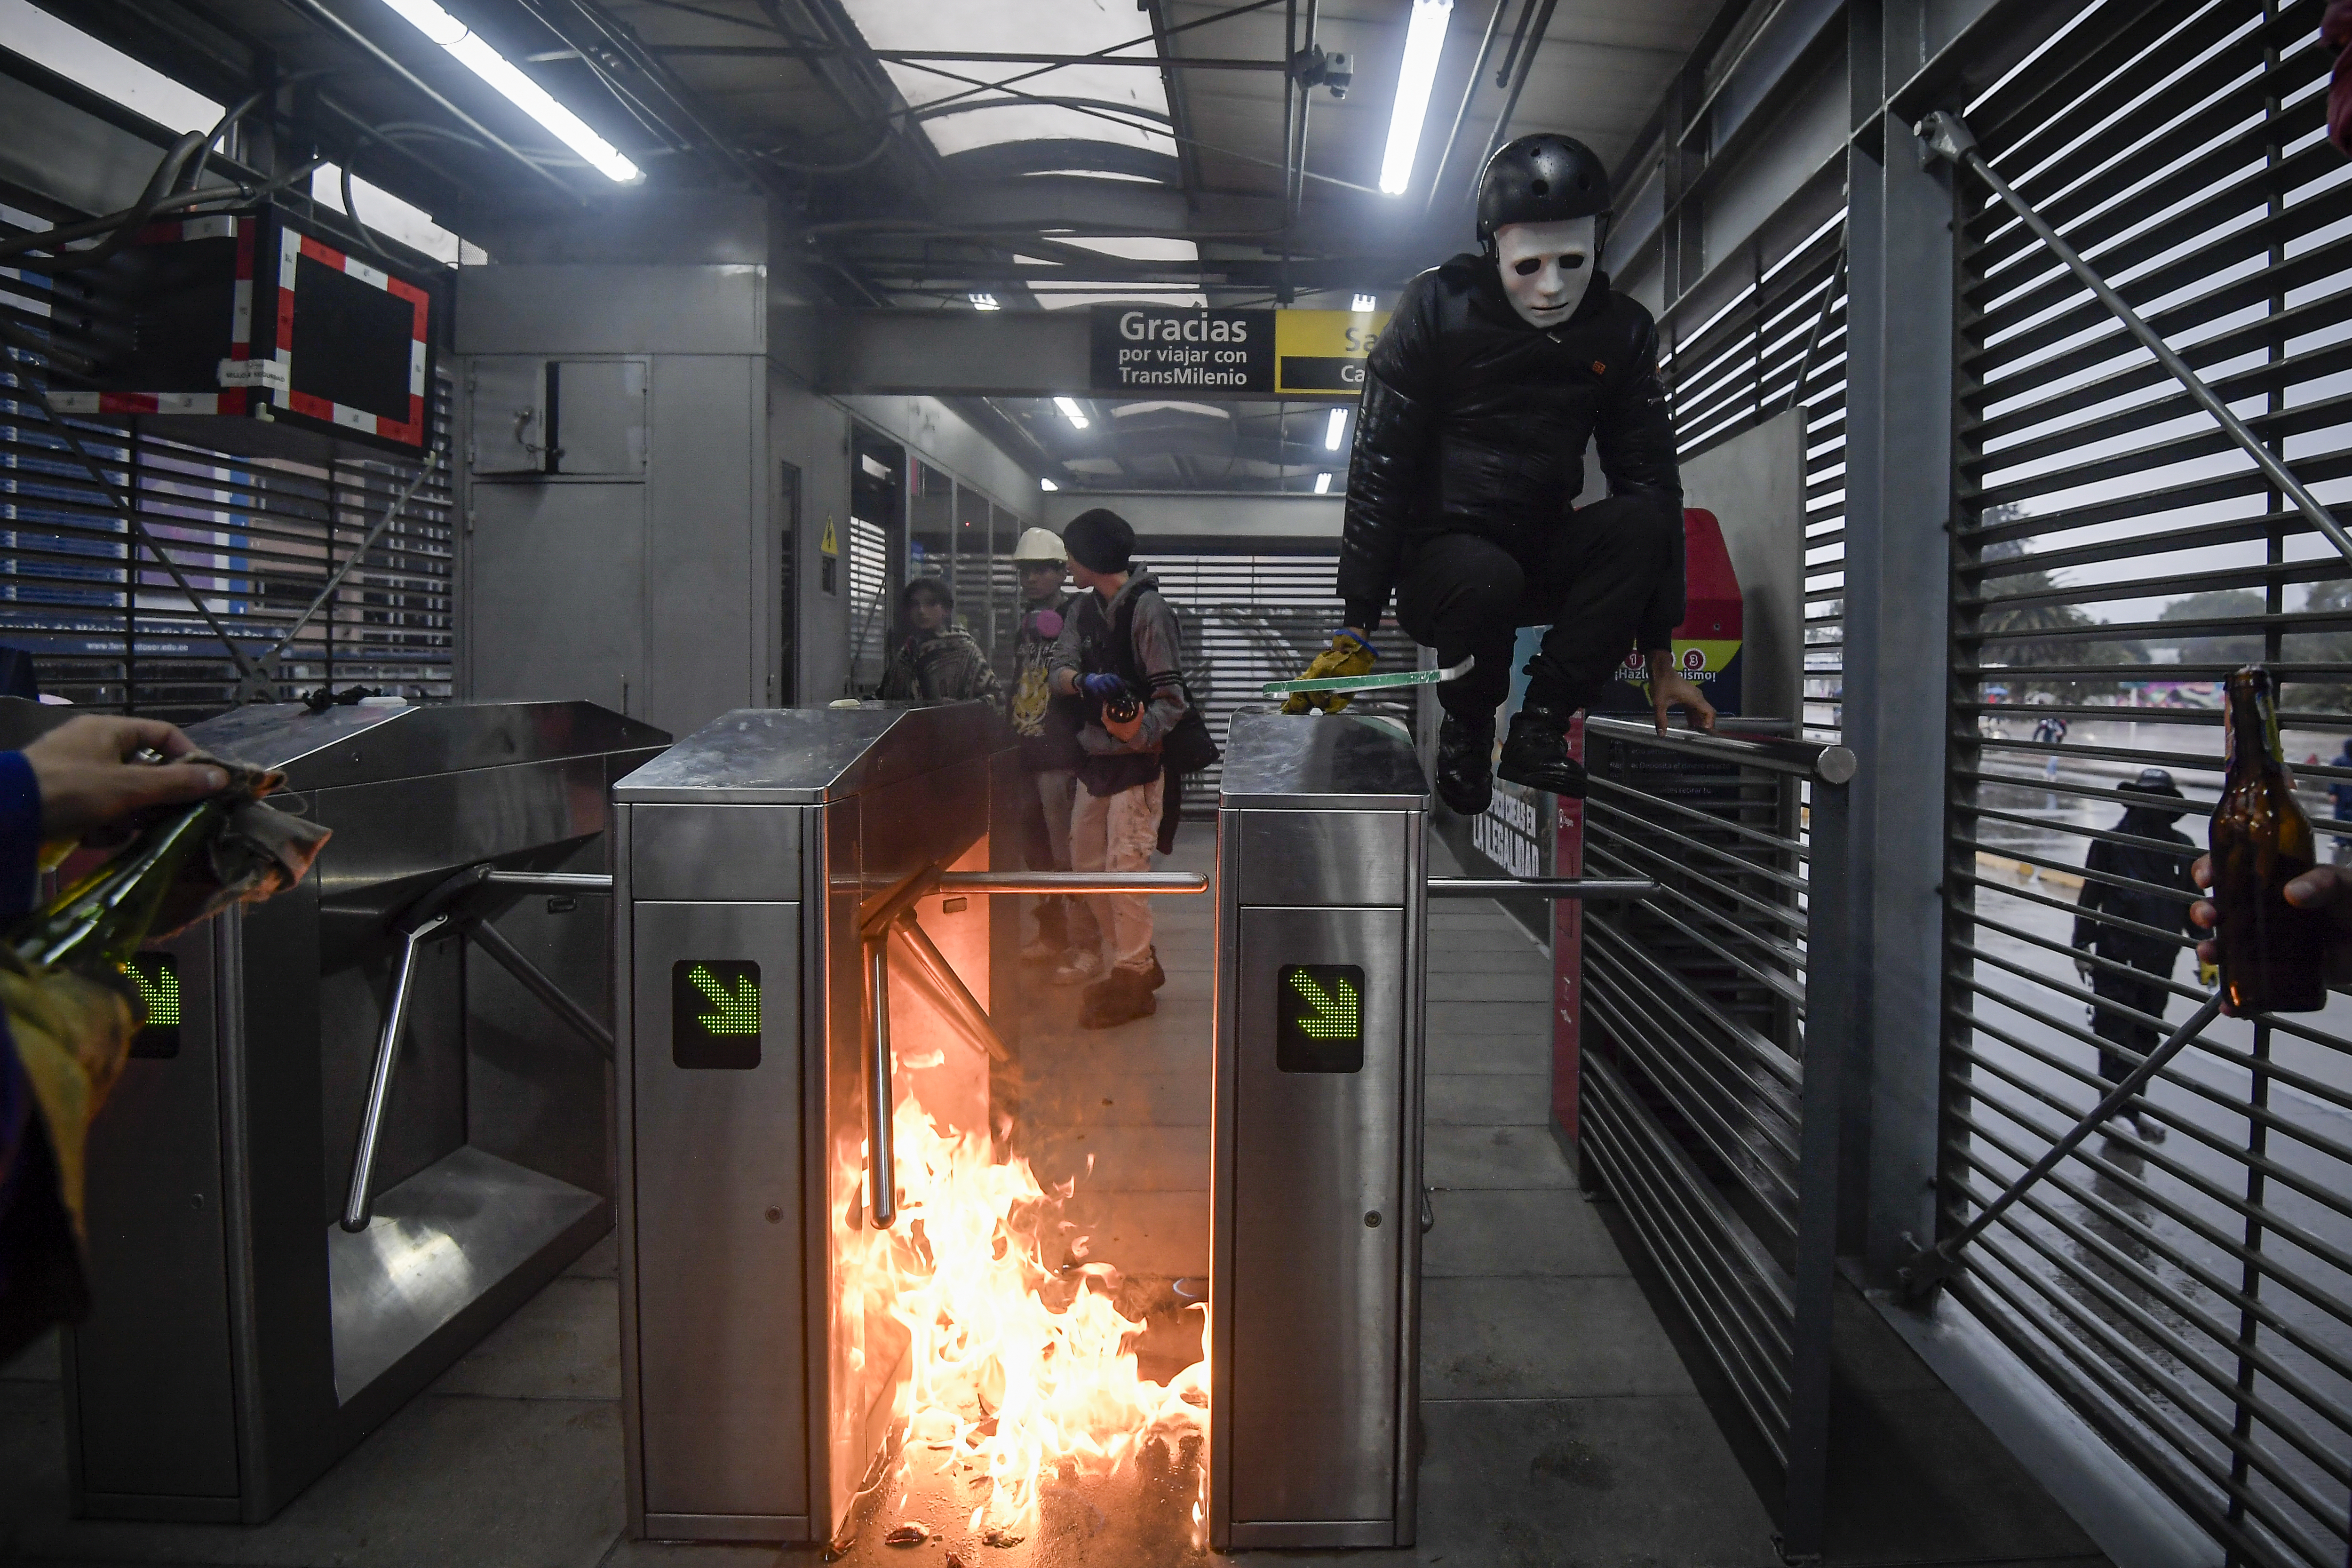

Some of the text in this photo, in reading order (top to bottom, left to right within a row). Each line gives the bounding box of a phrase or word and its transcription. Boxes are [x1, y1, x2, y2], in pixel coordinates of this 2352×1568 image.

[1120, 311, 1247, 342] Gracias
[1119, 346, 1247, 366] por viajar con
[1119, 367, 1247, 385] TransMilenio
[1629, 653, 1637, 665] 1
[1689, 654, 1698, 666] 3
